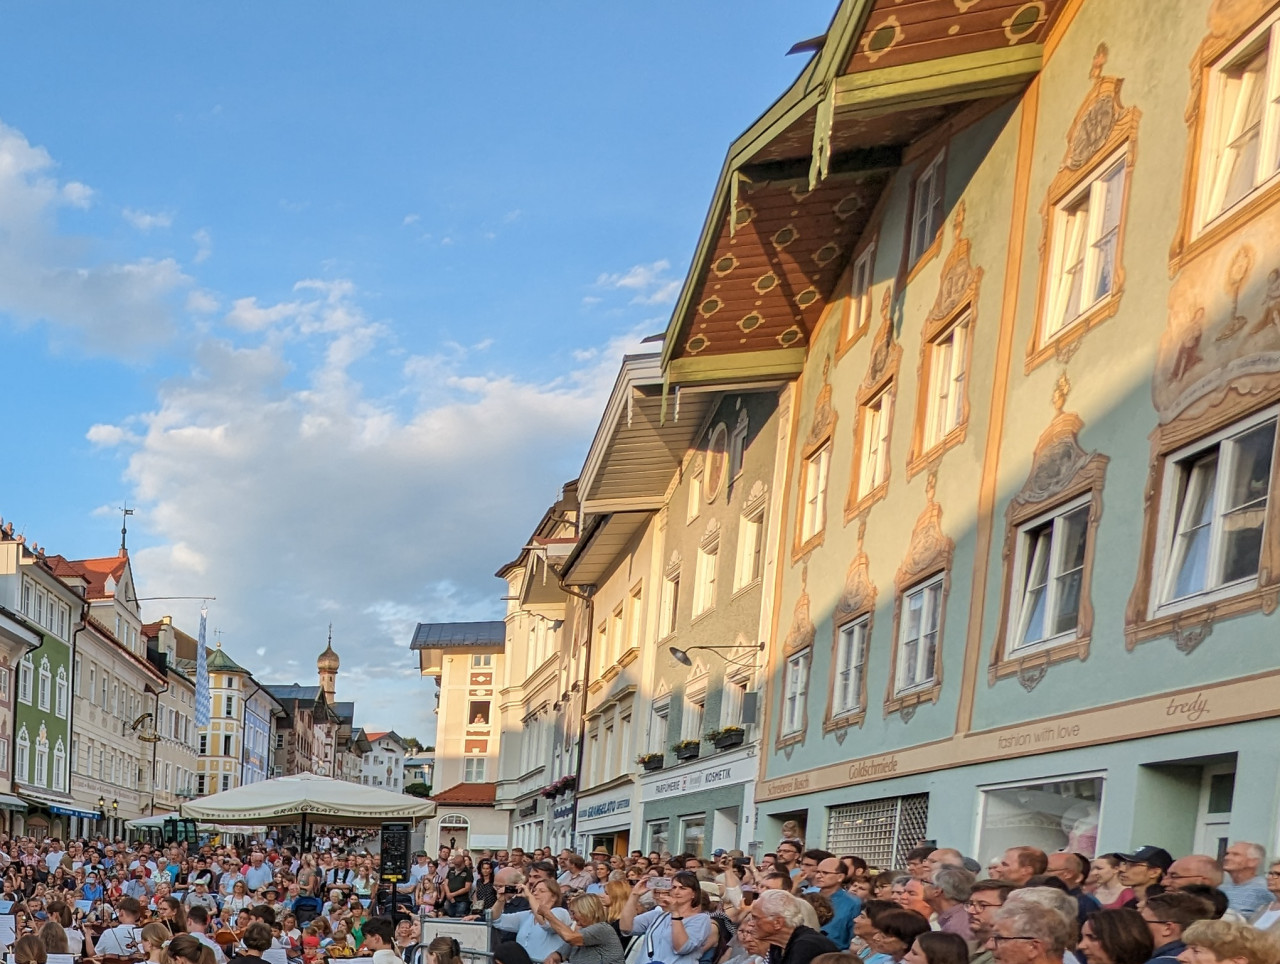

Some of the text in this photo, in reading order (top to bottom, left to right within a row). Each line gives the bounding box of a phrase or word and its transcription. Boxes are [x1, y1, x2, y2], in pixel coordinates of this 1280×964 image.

[1166, 693, 1210, 722] tredy
[998, 724, 1080, 749] fashion with love
[705, 768, 731, 783] KOSMETIK
[848, 756, 898, 780] Goldschmiede
